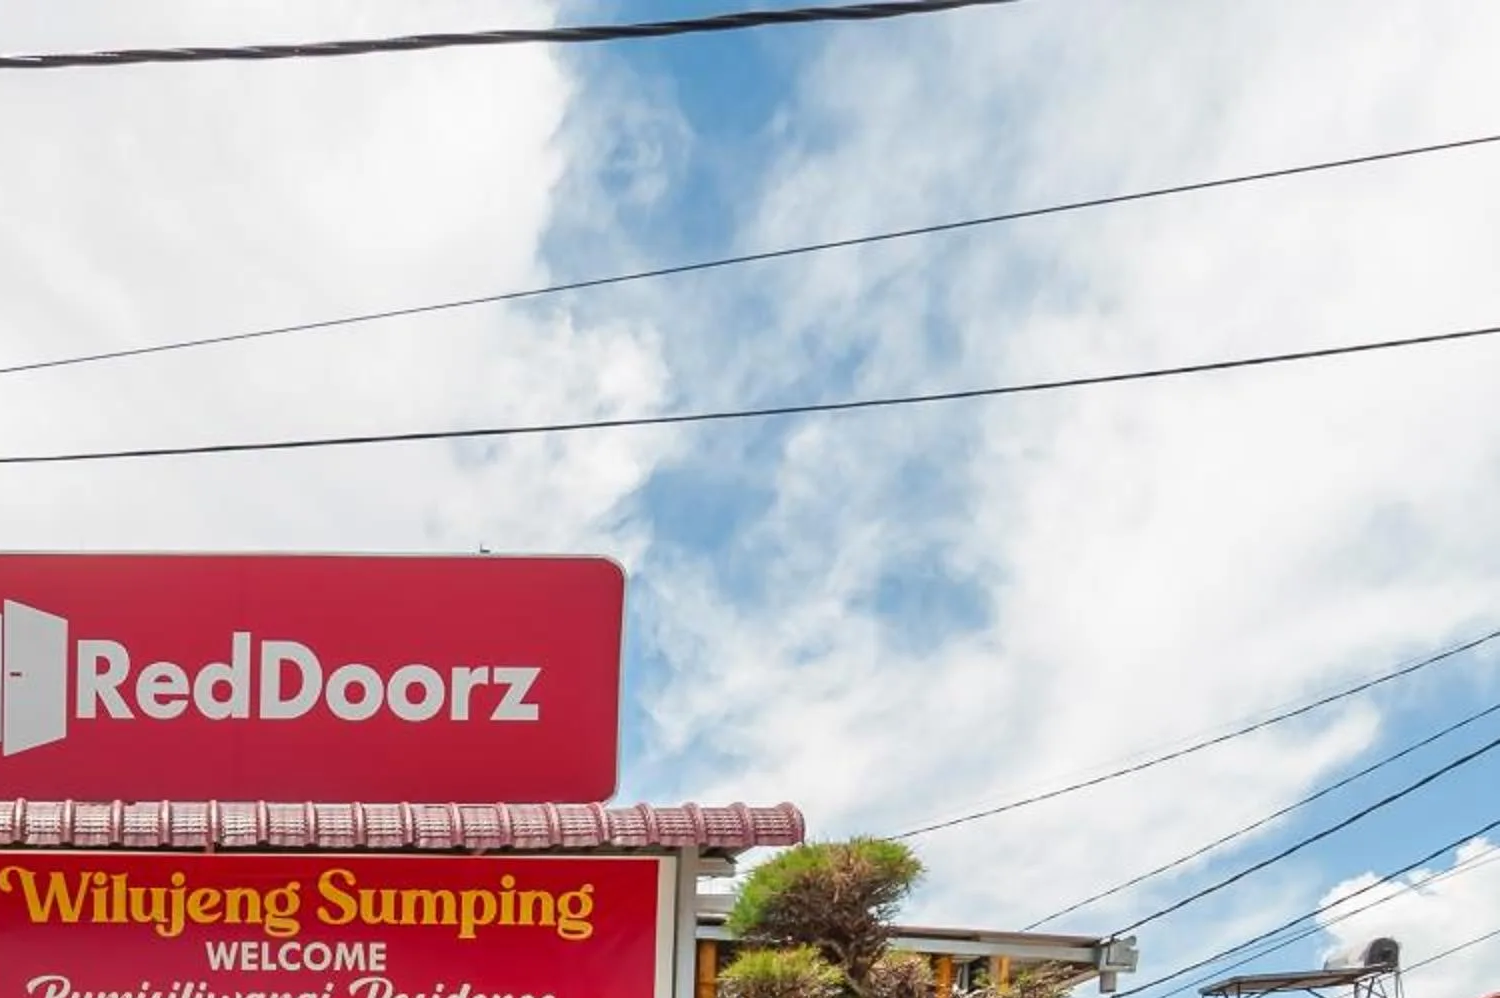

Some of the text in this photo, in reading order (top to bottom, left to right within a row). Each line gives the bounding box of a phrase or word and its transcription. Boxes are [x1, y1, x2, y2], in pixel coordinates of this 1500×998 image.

[76, 631, 542, 722] RedDoorz
[318, 868, 594, 940] Sumping
[206, 941, 386, 971] WELCOME
